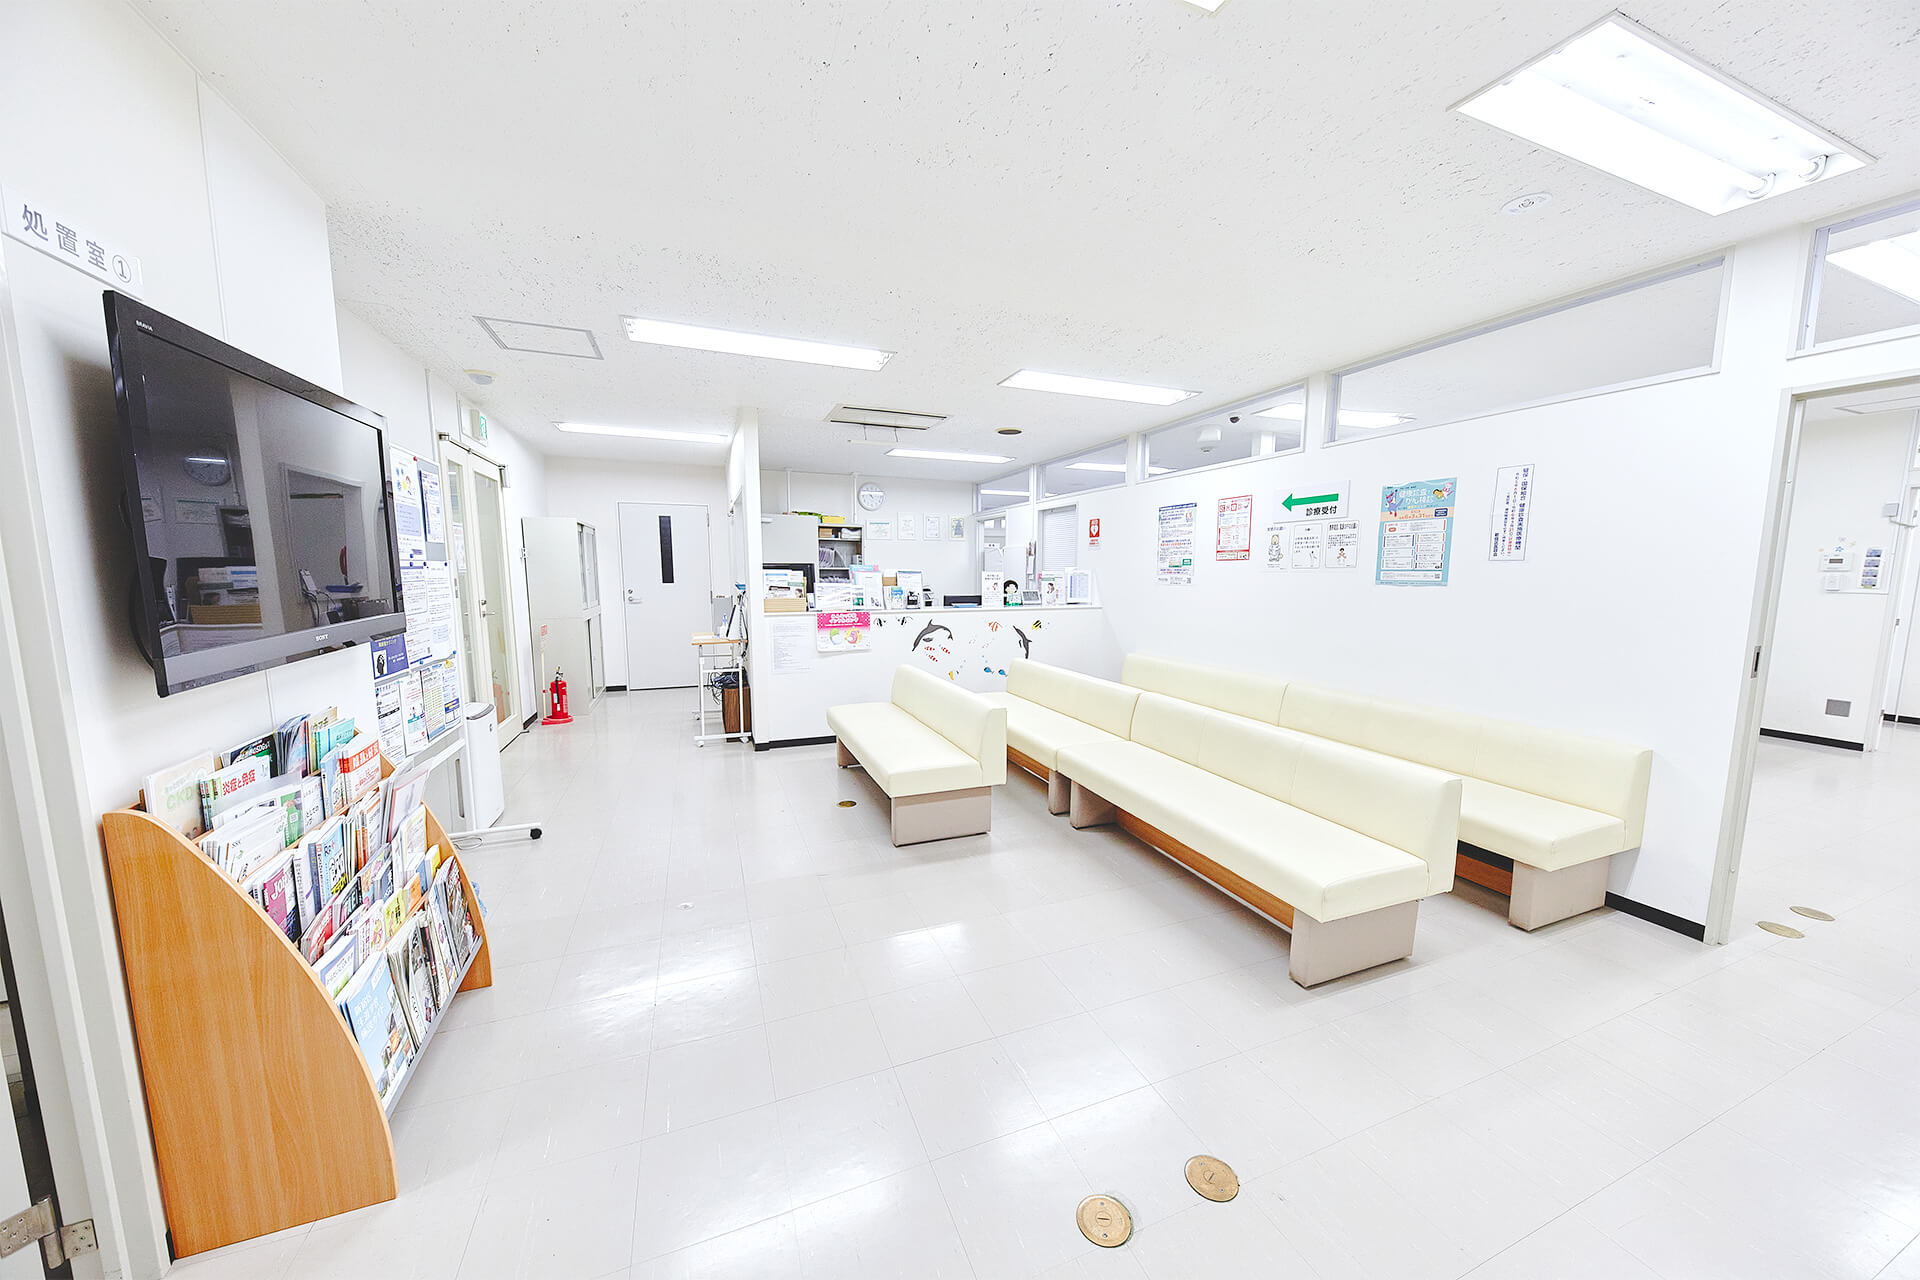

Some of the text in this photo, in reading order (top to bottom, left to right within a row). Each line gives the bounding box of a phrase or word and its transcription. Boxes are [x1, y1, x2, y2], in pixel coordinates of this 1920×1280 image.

[22, 204, 131, 283] 処置室①
[1306, 505, 1337, 516] 診療受付
[222, 769, 255, 796] 炎症と免疫
[166, 786, 193, 810] CKD
